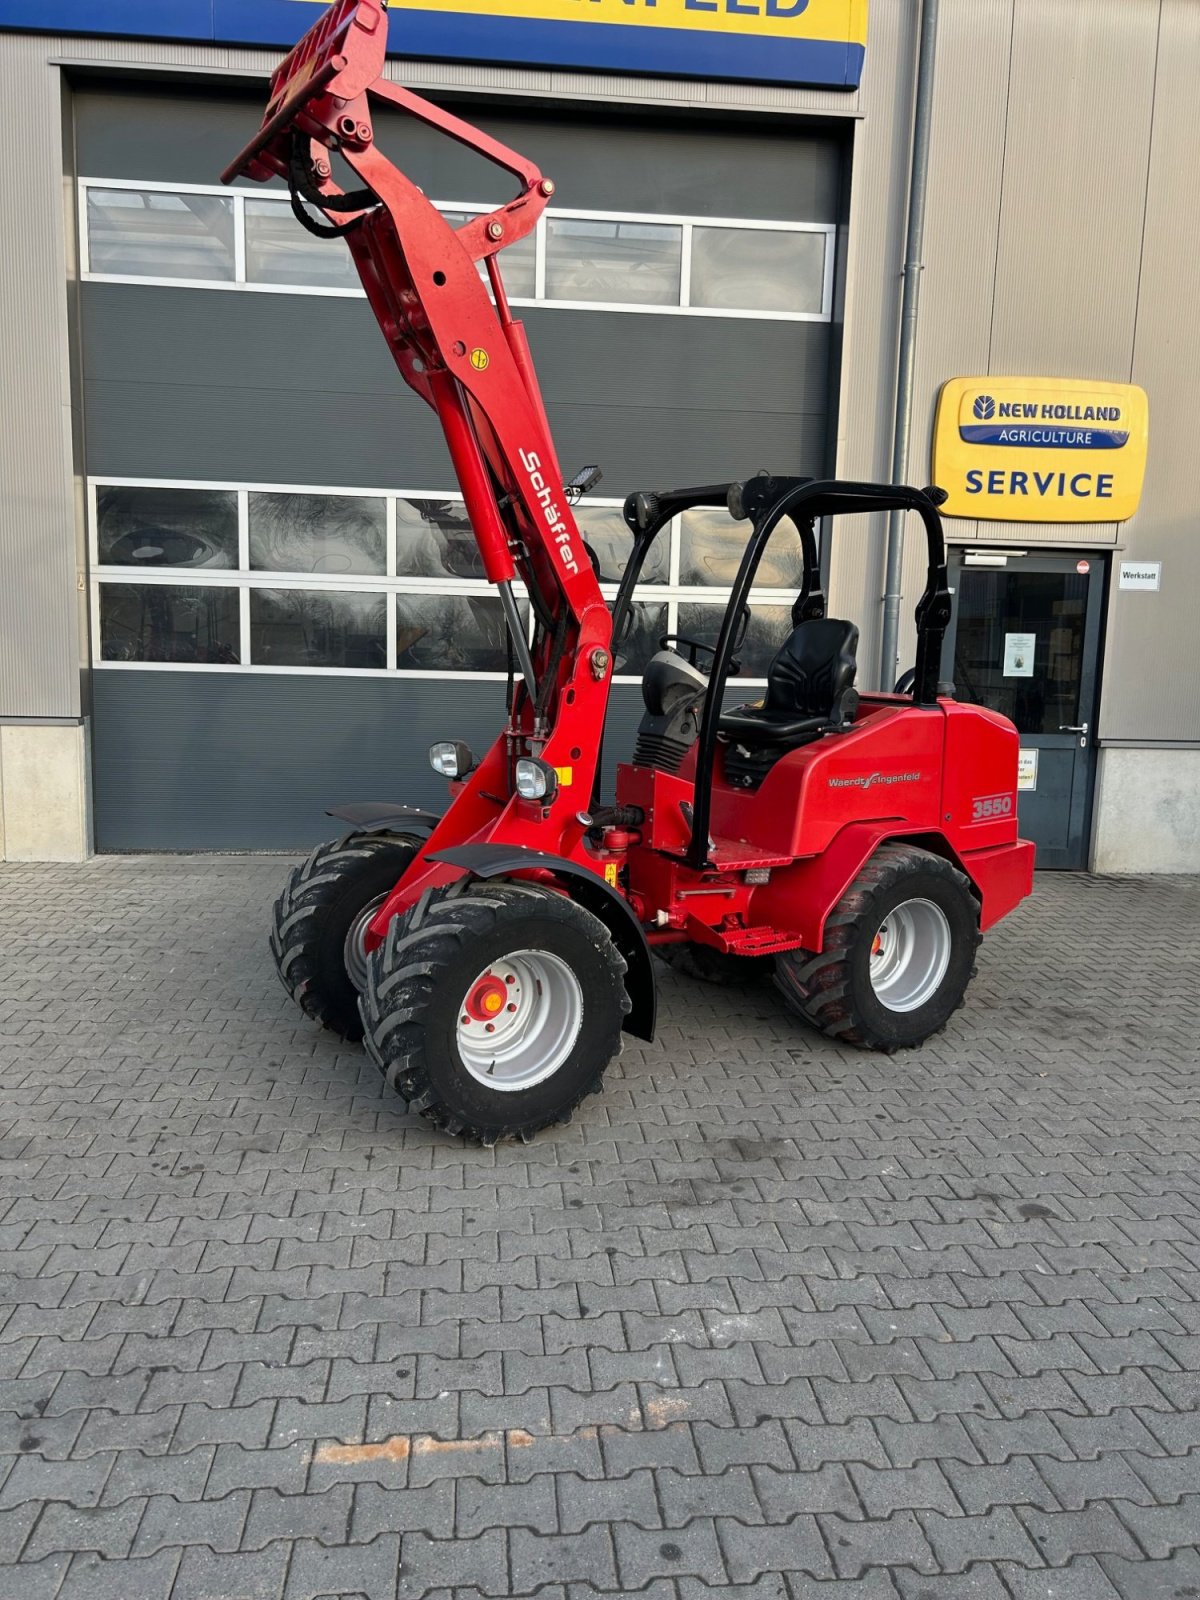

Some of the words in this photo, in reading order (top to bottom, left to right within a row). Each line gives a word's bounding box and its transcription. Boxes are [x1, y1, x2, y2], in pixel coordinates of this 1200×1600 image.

[998, 402, 1038, 419] NEW
[1041, 404, 1121, 422] HOLLAND
[998, 429, 1092, 445] AGRICULTURE
[965, 469, 1114, 498] SERVICE
[518, 447, 579, 575] Schäffer
[1122, 571, 1157, 580] Werkstatt
[877, 773, 921, 785] Ingenfeld
[973, 796, 1012, 818] 3550
